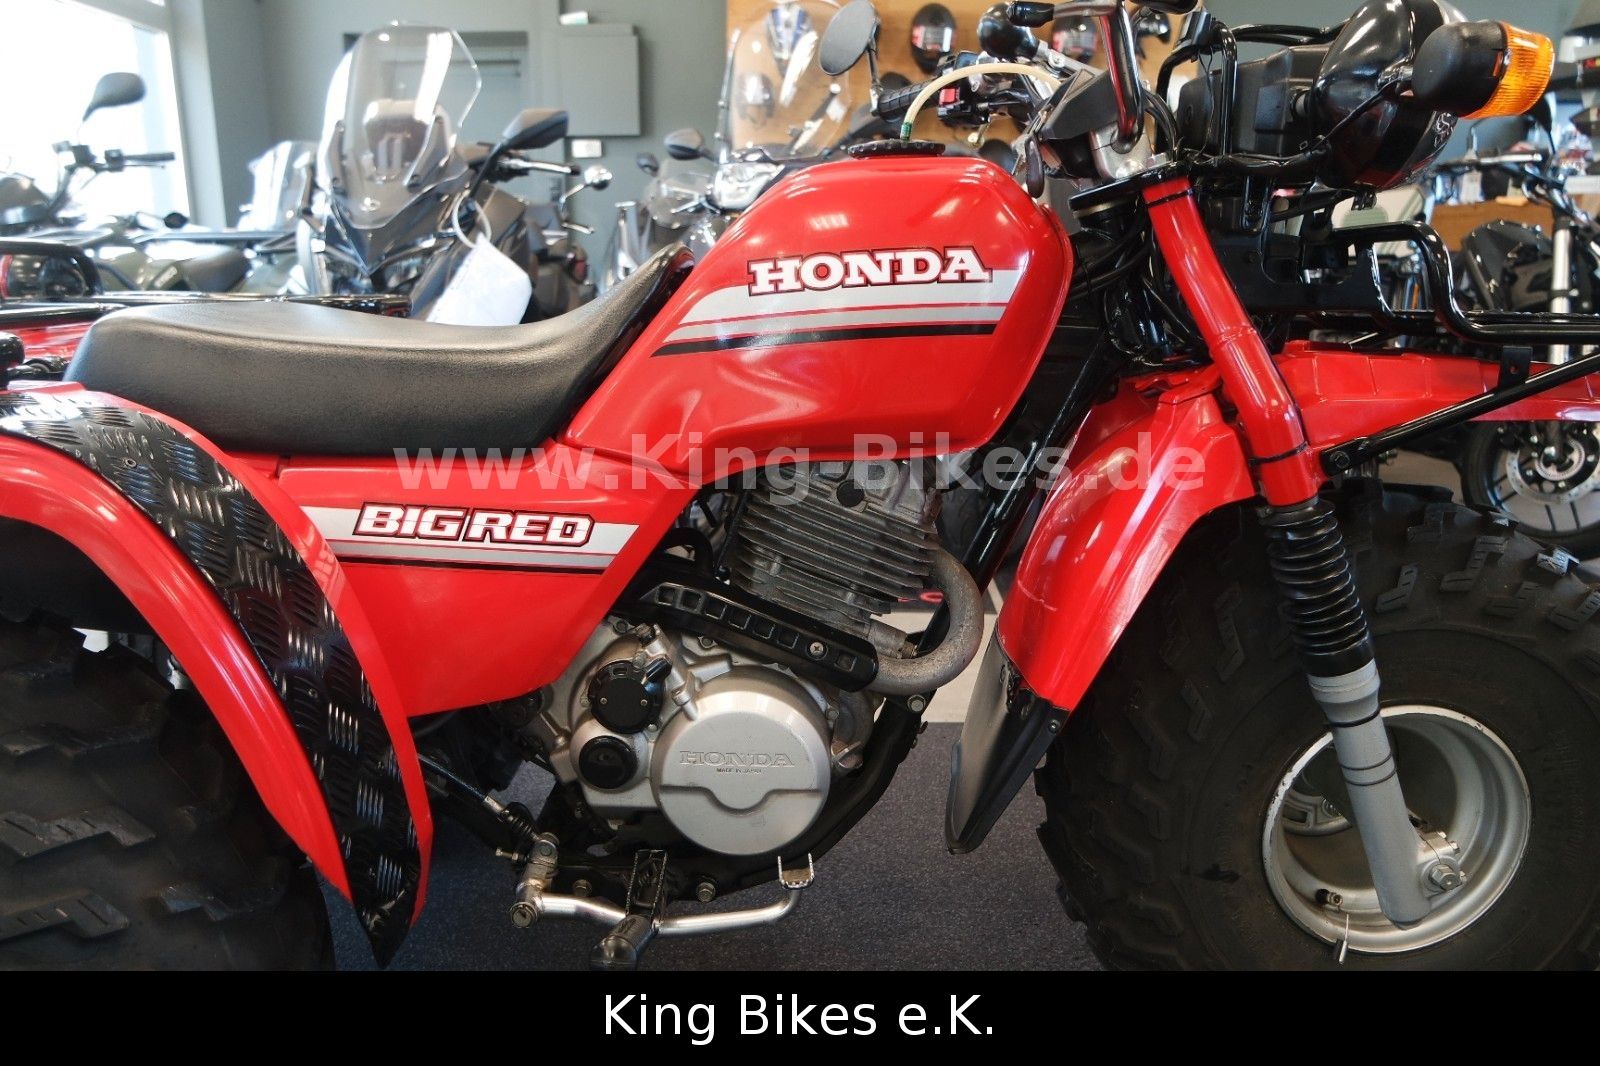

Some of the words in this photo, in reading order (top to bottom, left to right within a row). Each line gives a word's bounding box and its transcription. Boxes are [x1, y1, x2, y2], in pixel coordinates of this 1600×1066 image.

[748, 245, 993, 297] HONDA
[352, 501, 469, 541] BIG
[462, 507, 596, 547] RED
[679, 750, 795, 768] HONDA
